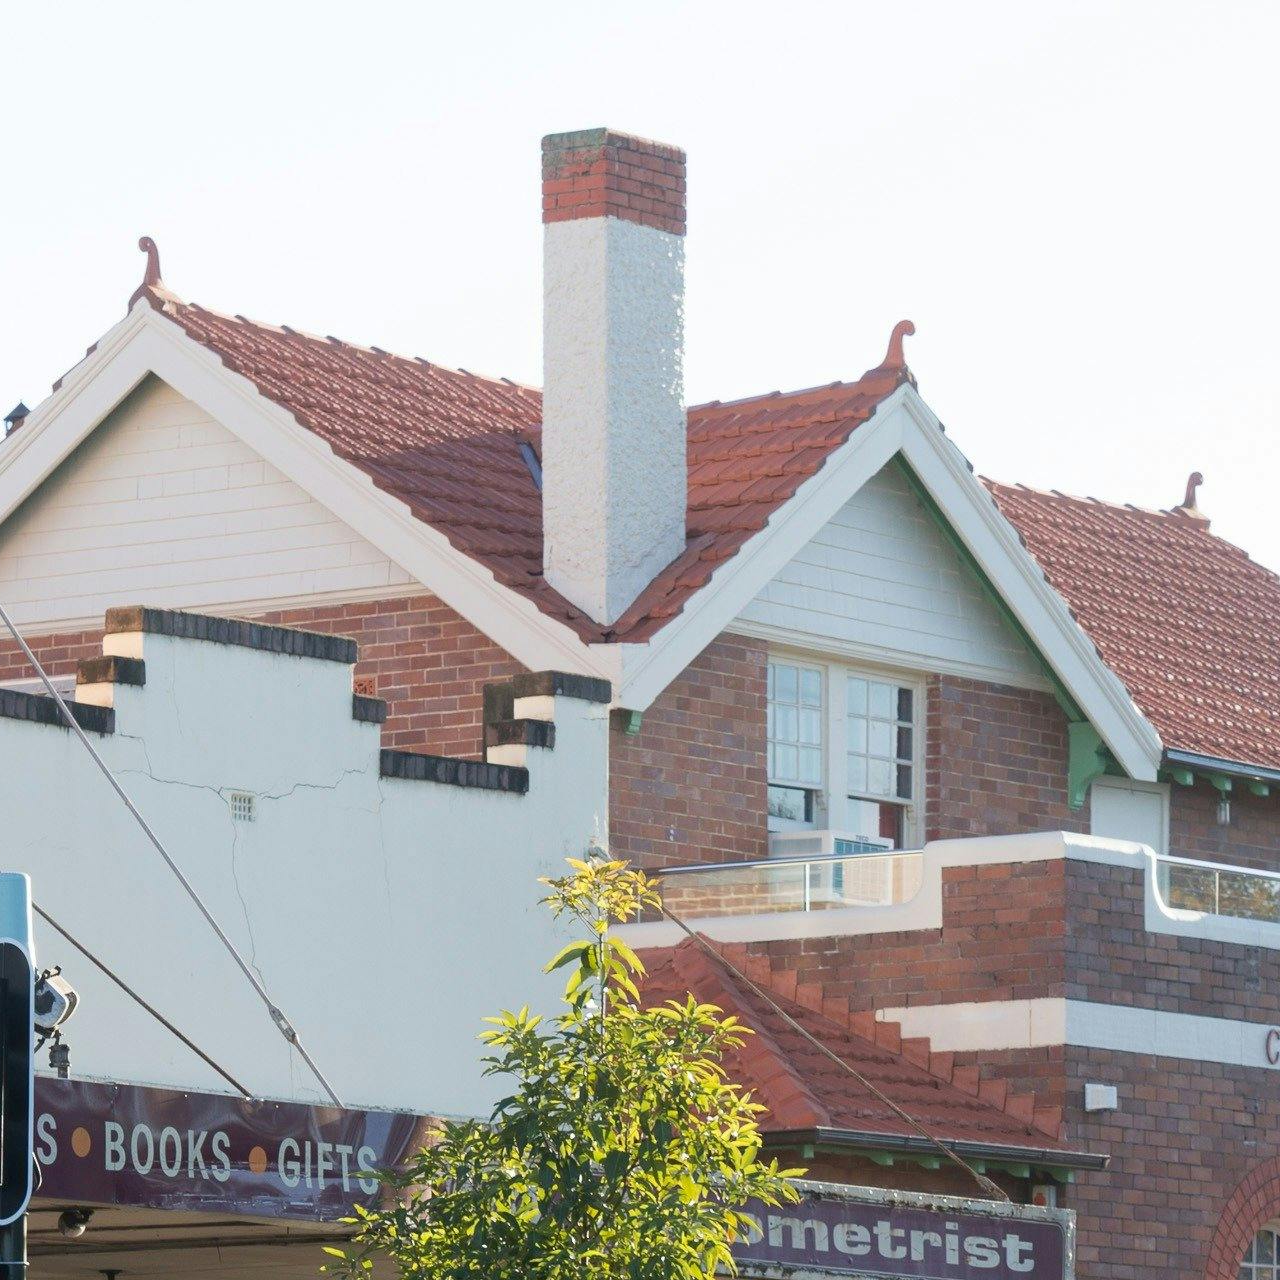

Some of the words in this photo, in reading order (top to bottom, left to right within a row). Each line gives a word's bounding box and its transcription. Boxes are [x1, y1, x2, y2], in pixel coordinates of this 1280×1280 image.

[104, 1121, 231, 1182] BOOKS
[278, 1137, 380, 1195] GIFTS
[727, 1211, 1035, 1272] ometrist
